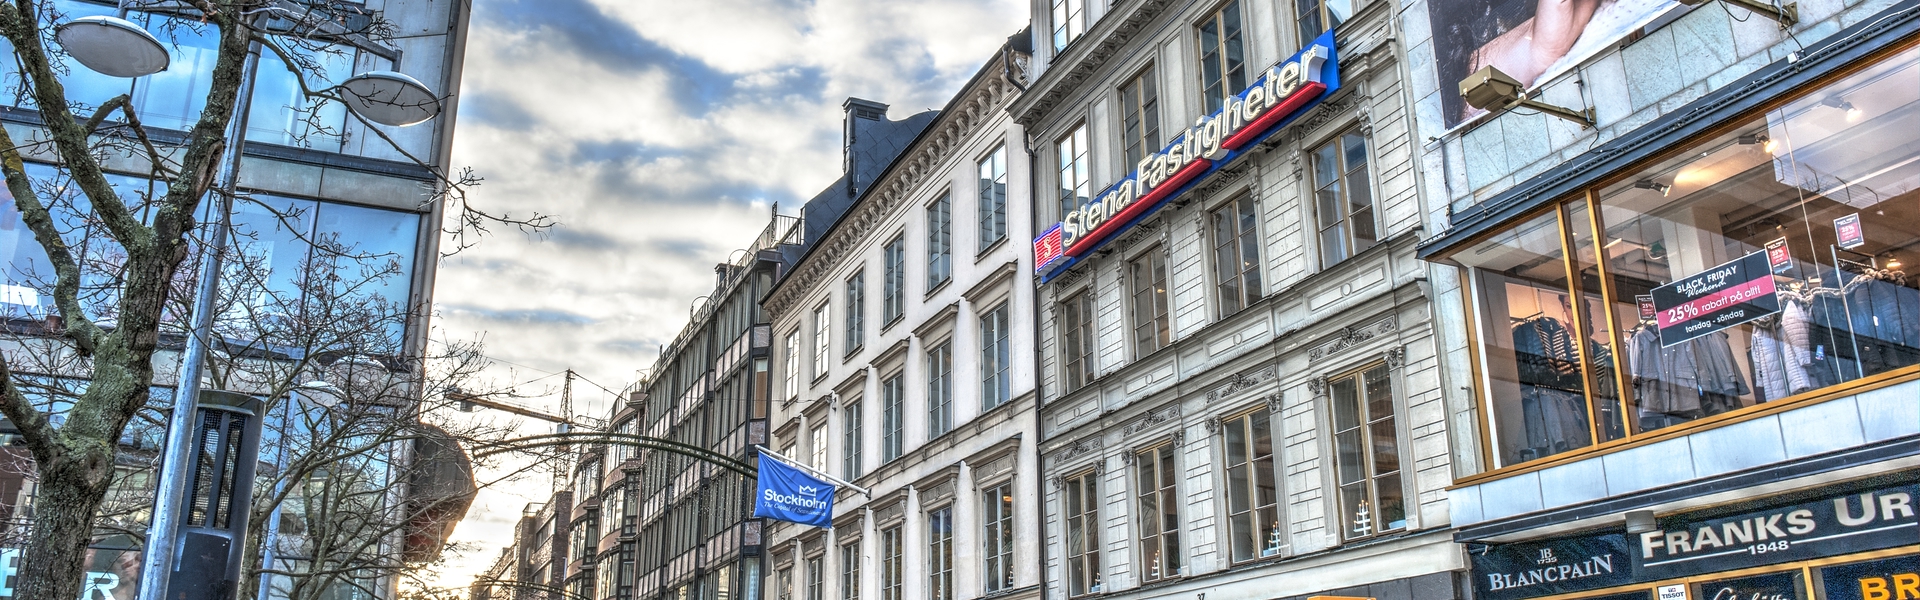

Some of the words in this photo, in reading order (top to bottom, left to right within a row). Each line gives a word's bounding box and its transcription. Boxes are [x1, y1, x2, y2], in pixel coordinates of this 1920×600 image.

[1063, 179, 1135, 247] Stena
[1136, 44, 1328, 160] Fastigheter
[1676, 278, 1704, 294] BLACK
[1707, 265, 1737, 283] FRIDAY
[1668, 302, 1698, 323] 25%
[1701, 296, 1728, 312] rabatt
[1729, 290, 1743, 303] på
[1685, 320, 1711, 333] torsdag
[1717, 309, 1744, 323] söndag
[764, 489, 827, 510] Stockholm
[1640, 508, 1816, 558] FRANKS
[1833, 492, 1915, 526] UR
[1537, 556, 1558, 565] 1735
[1748, 540, 1789, 555] 1948
[1487, 554, 1612, 591] BLANCPAIN
